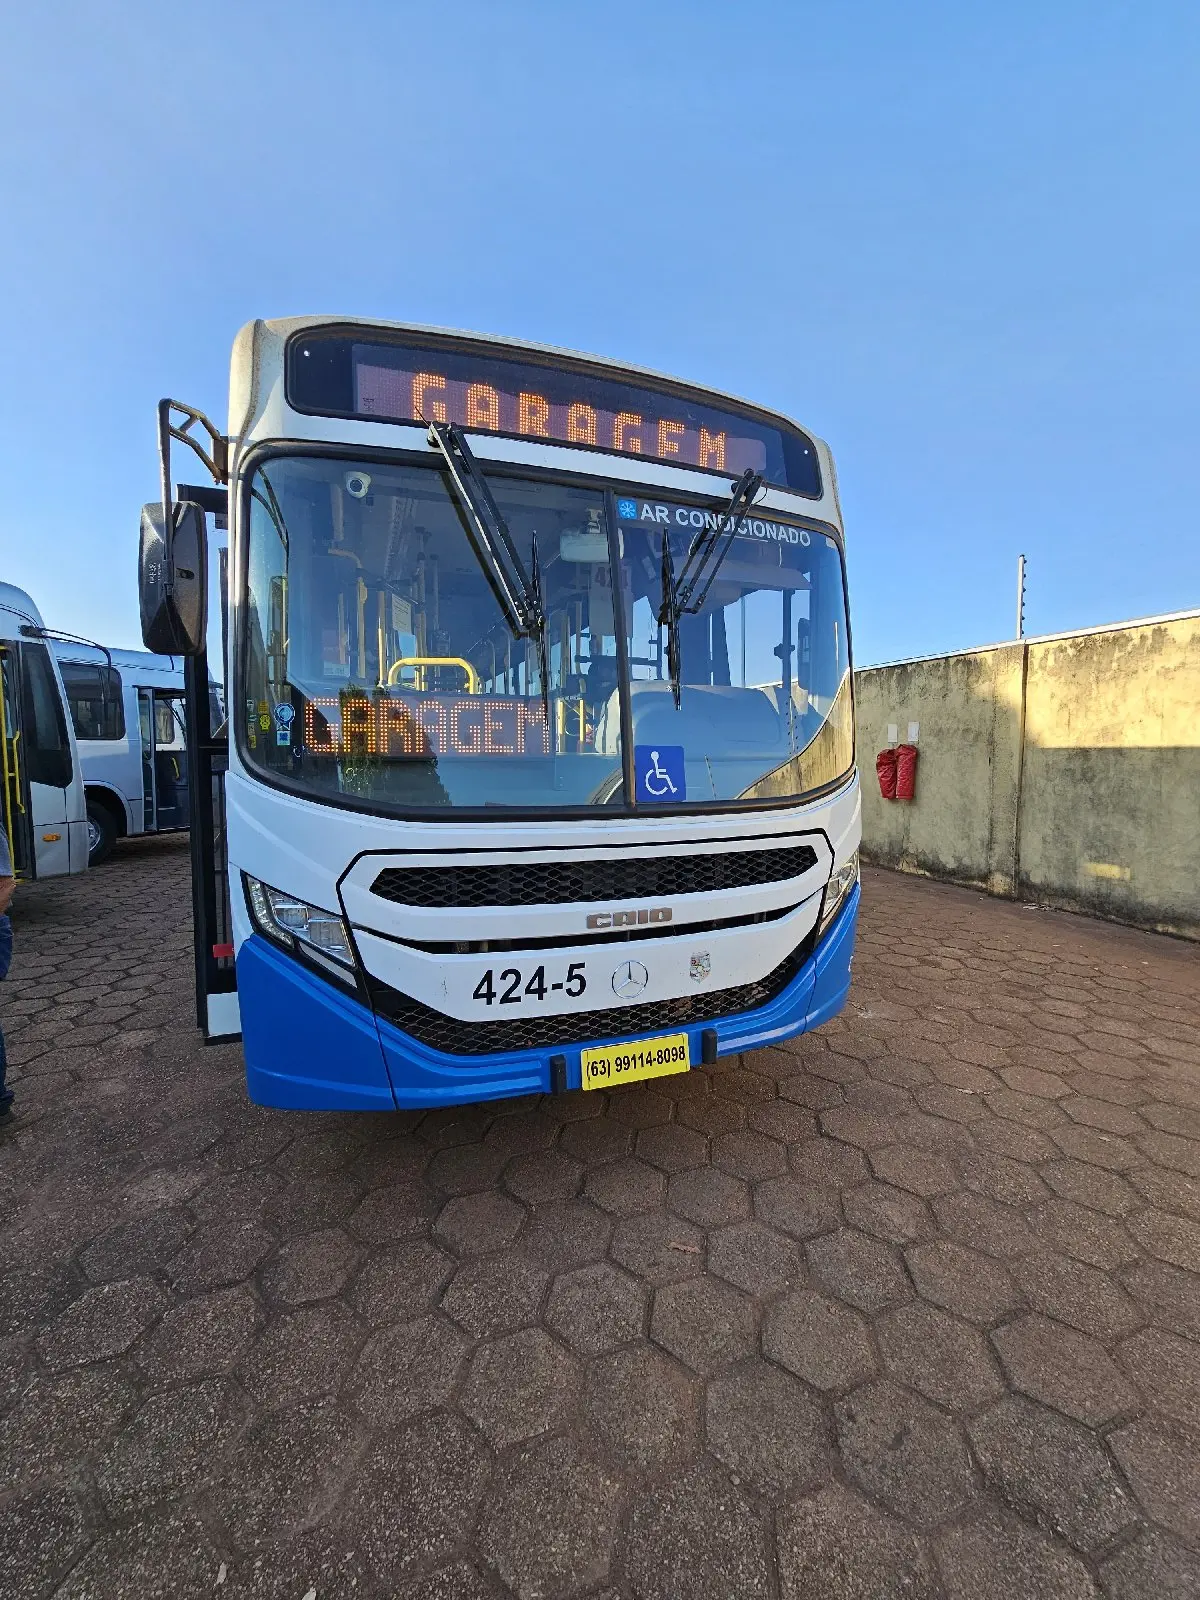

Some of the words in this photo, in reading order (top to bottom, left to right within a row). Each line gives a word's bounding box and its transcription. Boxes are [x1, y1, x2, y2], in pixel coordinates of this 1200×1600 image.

[641, 503, 671, 524] AR
[305, 697, 550, 753] GARAGEM
[586, 907, 673, 929] CAIO
[472, 962, 587, 1005] 424-5
[586, 1058, 611, 1078] (63)
[615, 1045, 686, 1073] 99114-8098
